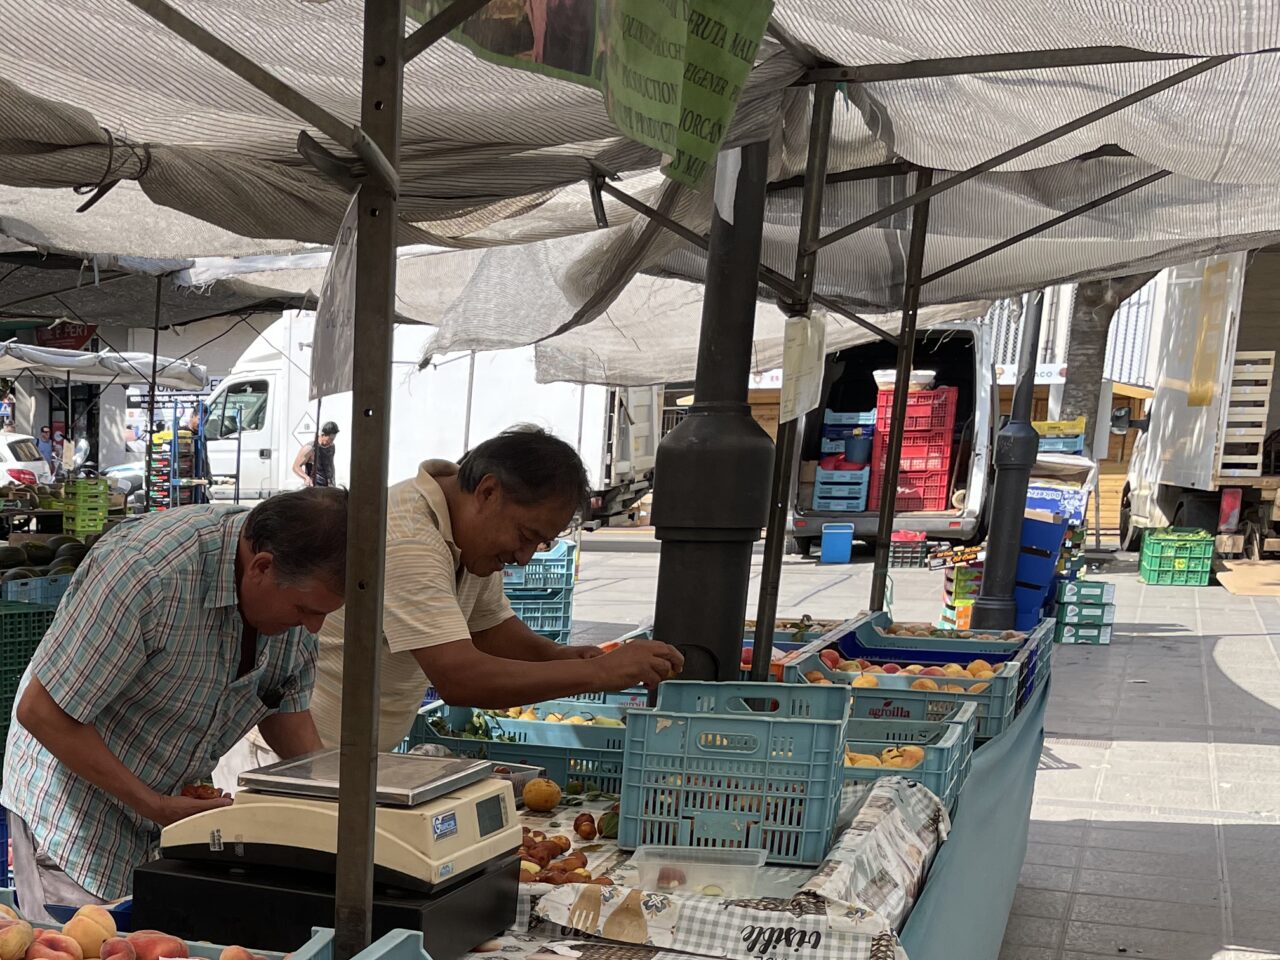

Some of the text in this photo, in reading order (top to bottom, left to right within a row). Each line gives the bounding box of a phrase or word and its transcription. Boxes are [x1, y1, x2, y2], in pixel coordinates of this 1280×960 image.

[688, 9, 728, 49] FRUTA
[683, 62, 729, 97] EIGENER
[869, 706, 911, 719] agroilla
[741, 924, 822, 955] visible
